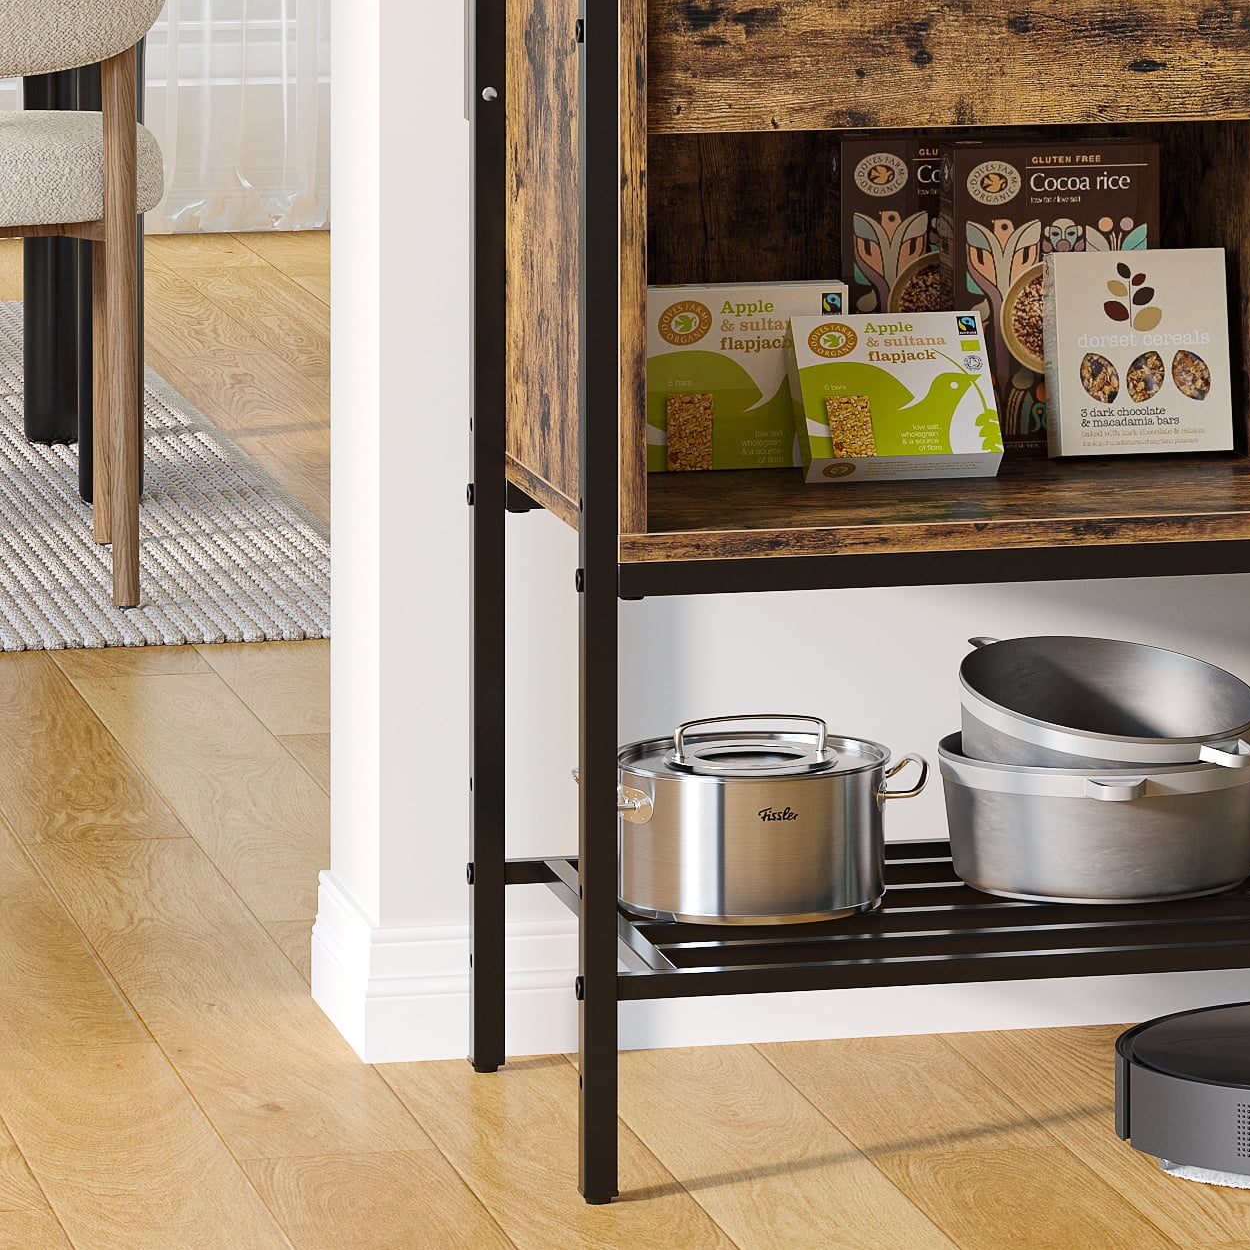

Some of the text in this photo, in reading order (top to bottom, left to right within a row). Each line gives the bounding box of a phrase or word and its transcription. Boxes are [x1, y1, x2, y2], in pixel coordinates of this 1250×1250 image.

[1031, 155, 1101, 164] GLUTEN FREE
[970, 164, 1018, 186] DOVES FARM
[1030, 171, 1131, 192] Cocoa rice
[860, 180, 902, 194] ORGANIC
[974, 189, 1016, 203] ORGANIC
[719, 299, 774, 317] Apple
[662, 303, 709, 330] DOVES FARM
[720, 319, 735, 332] &
[864, 321, 914, 336] Apple
[666, 323, 709, 344] ORGANIC
[811, 324, 852, 346] DOVES FARM
[866, 335, 947, 347] & sultana
[1077, 329, 1211, 348] dorset cereals
[817, 341, 855, 357] ORGANIC
[868, 349, 937, 364] flapjack
[1080, 406, 1166, 418] 3 dark chocolate
[1081, 416, 1180, 428] & macadamia bars
[757, 806, 799, 822] Fissler
